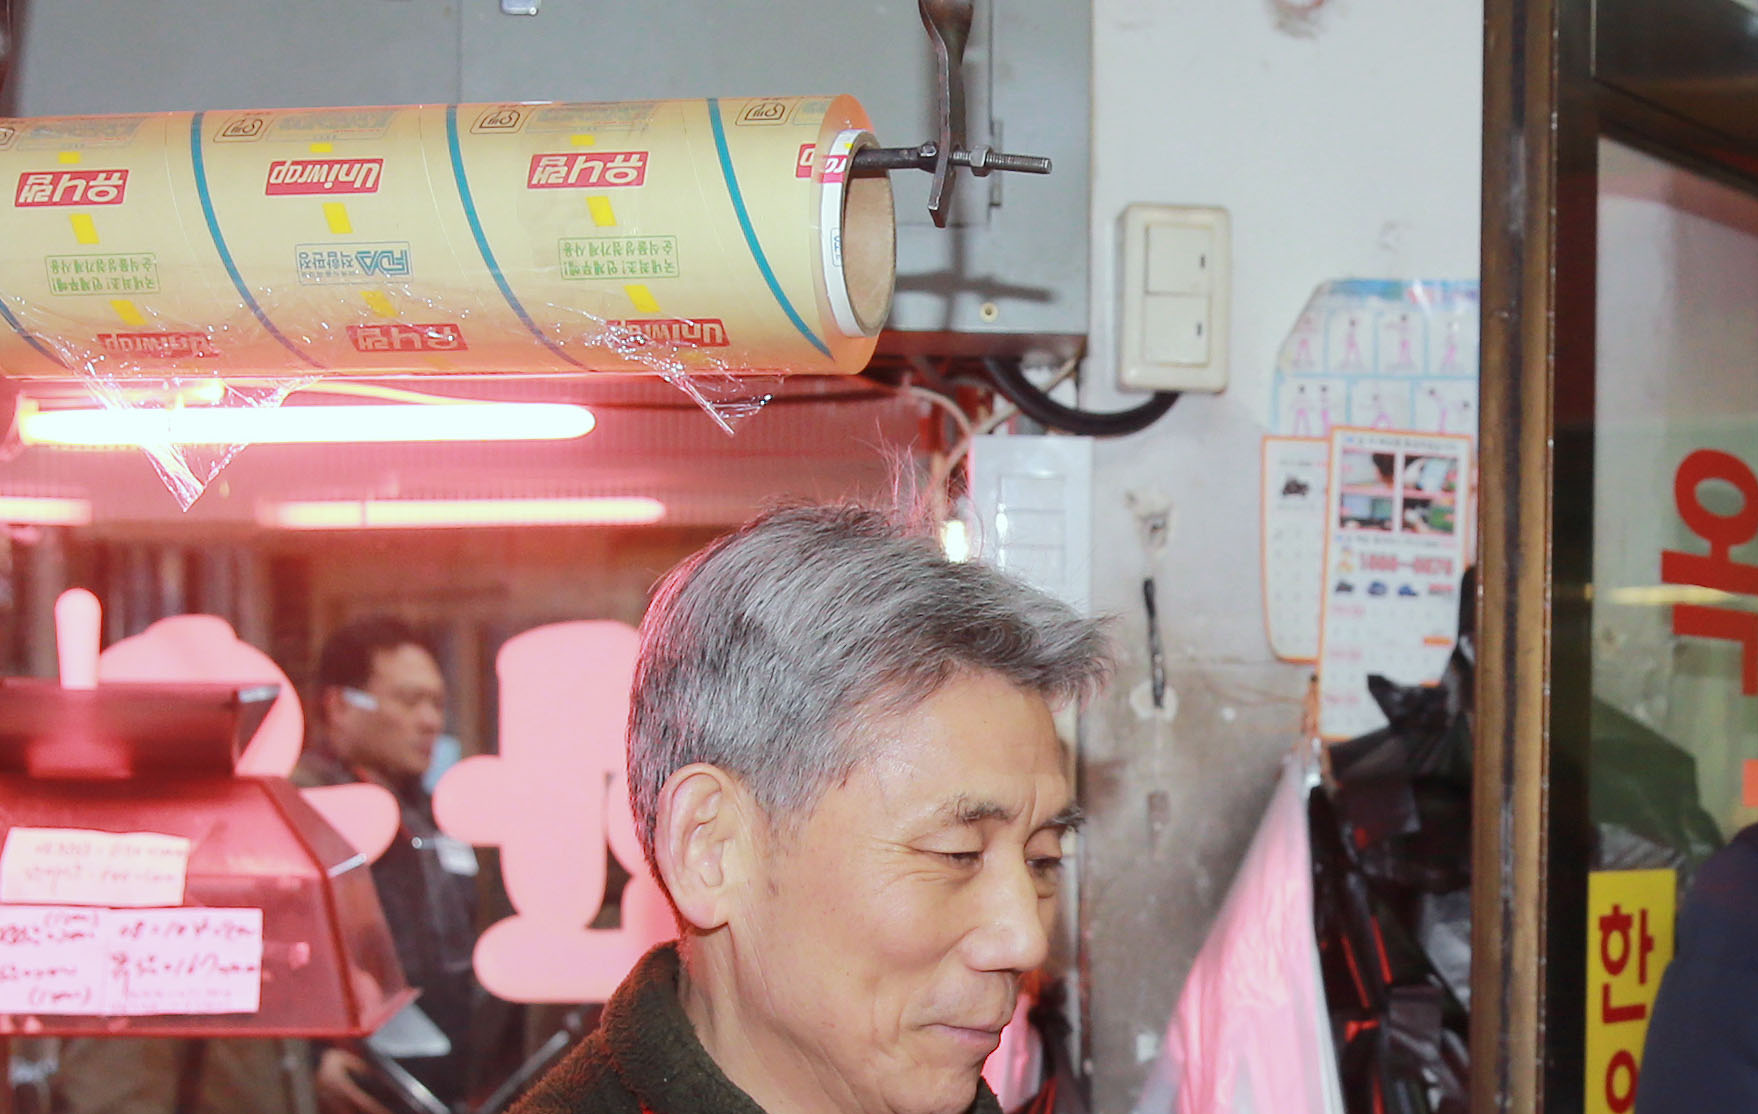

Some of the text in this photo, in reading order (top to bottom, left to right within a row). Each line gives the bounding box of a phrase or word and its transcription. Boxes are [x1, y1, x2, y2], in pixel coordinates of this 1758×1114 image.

[269, 161, 382, 190] Uniwrap
[531, 157, 645, 185] 유니랩
[20, 172, 125, 204] 유니랩
[298, 251, 354, 270] 적합판정
[355, 249, 410, 276] FDA
[356, 326, 460, 351] 유니랩
